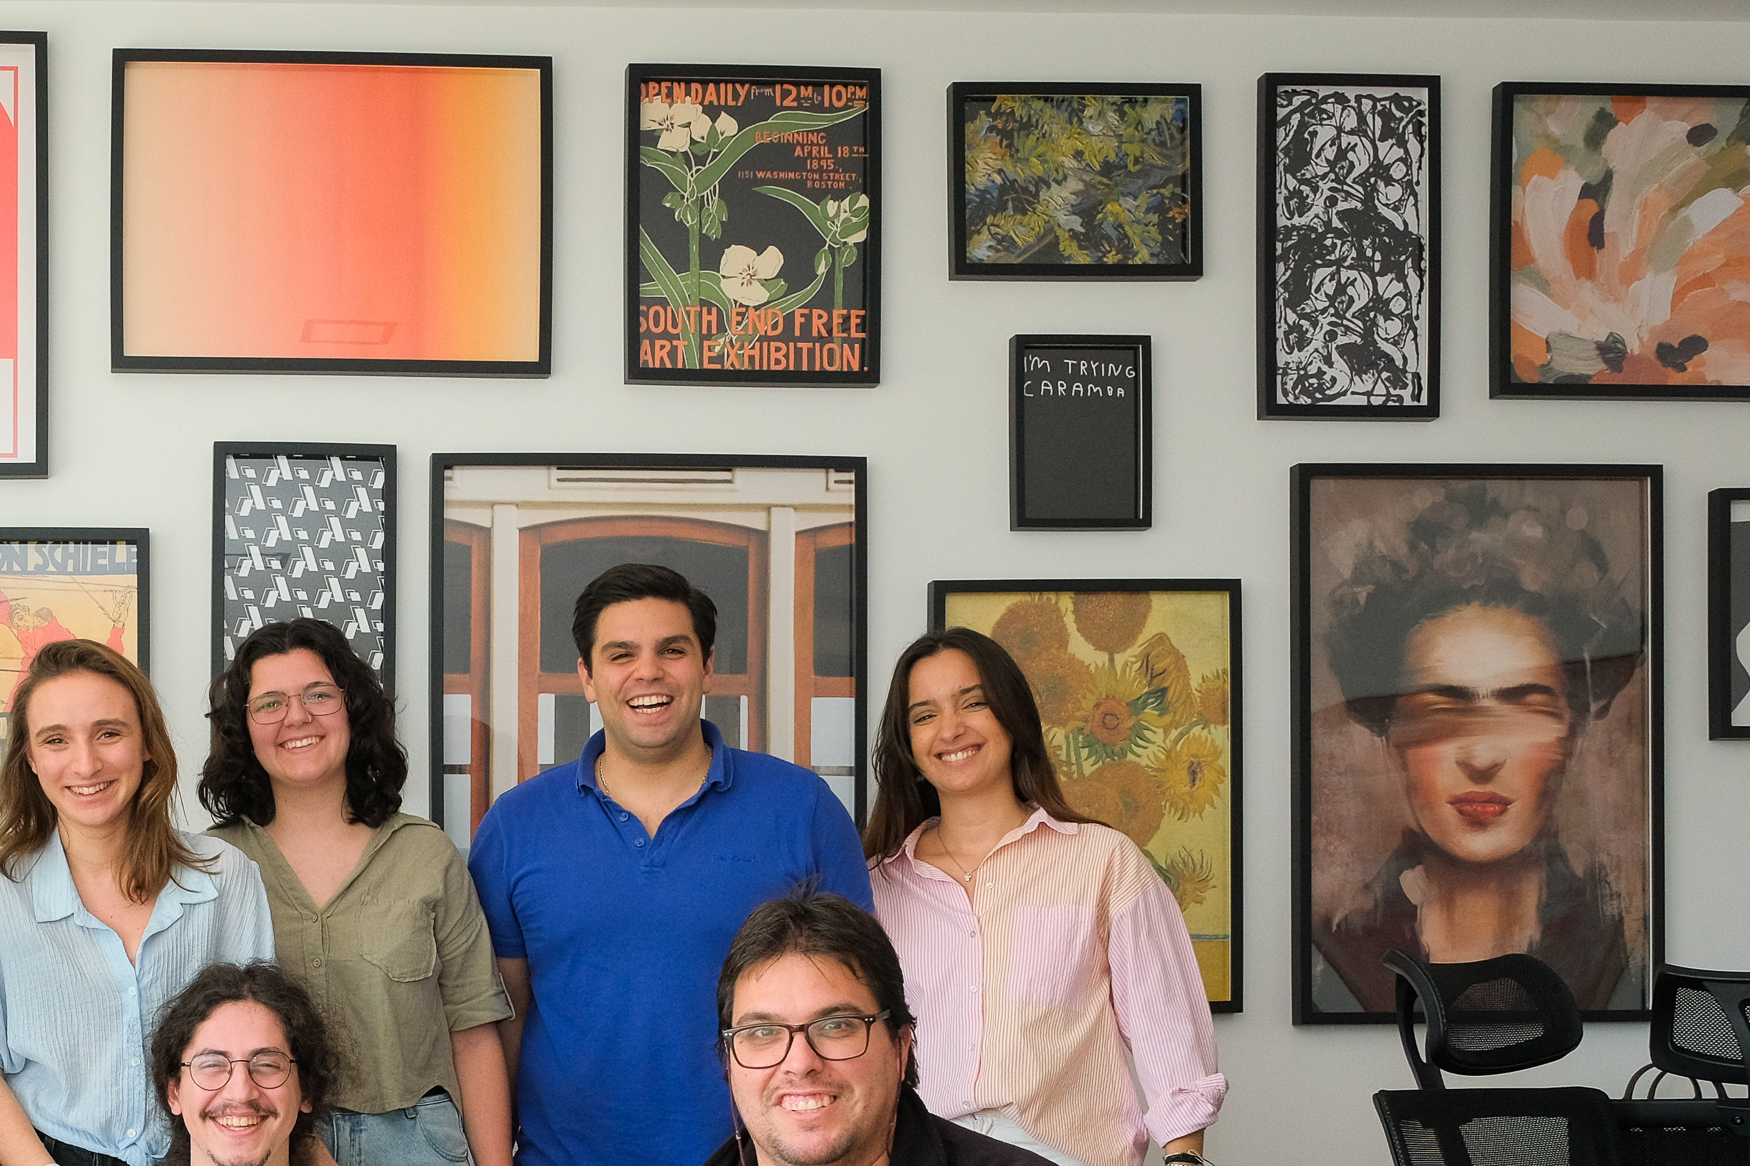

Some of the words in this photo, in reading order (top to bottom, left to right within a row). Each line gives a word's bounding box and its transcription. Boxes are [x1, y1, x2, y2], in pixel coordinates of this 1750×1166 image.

[690, 82, 750, 106] DAILY
[755, 131, 827, 144] BEGINNING
[794, 145, 833, 158] APRIL
[756, 171, 820, 180] WASHINGTON
[730, 306, 784, 336] END
[794, 308, 867, 338] FREE
[640, 338, 689, 369] ART
[1024, 354, 1051, 373] I'M
[1063, 359, 1136, 378] TRYING
[1023, 380, 1125, 398] CARAMBA
